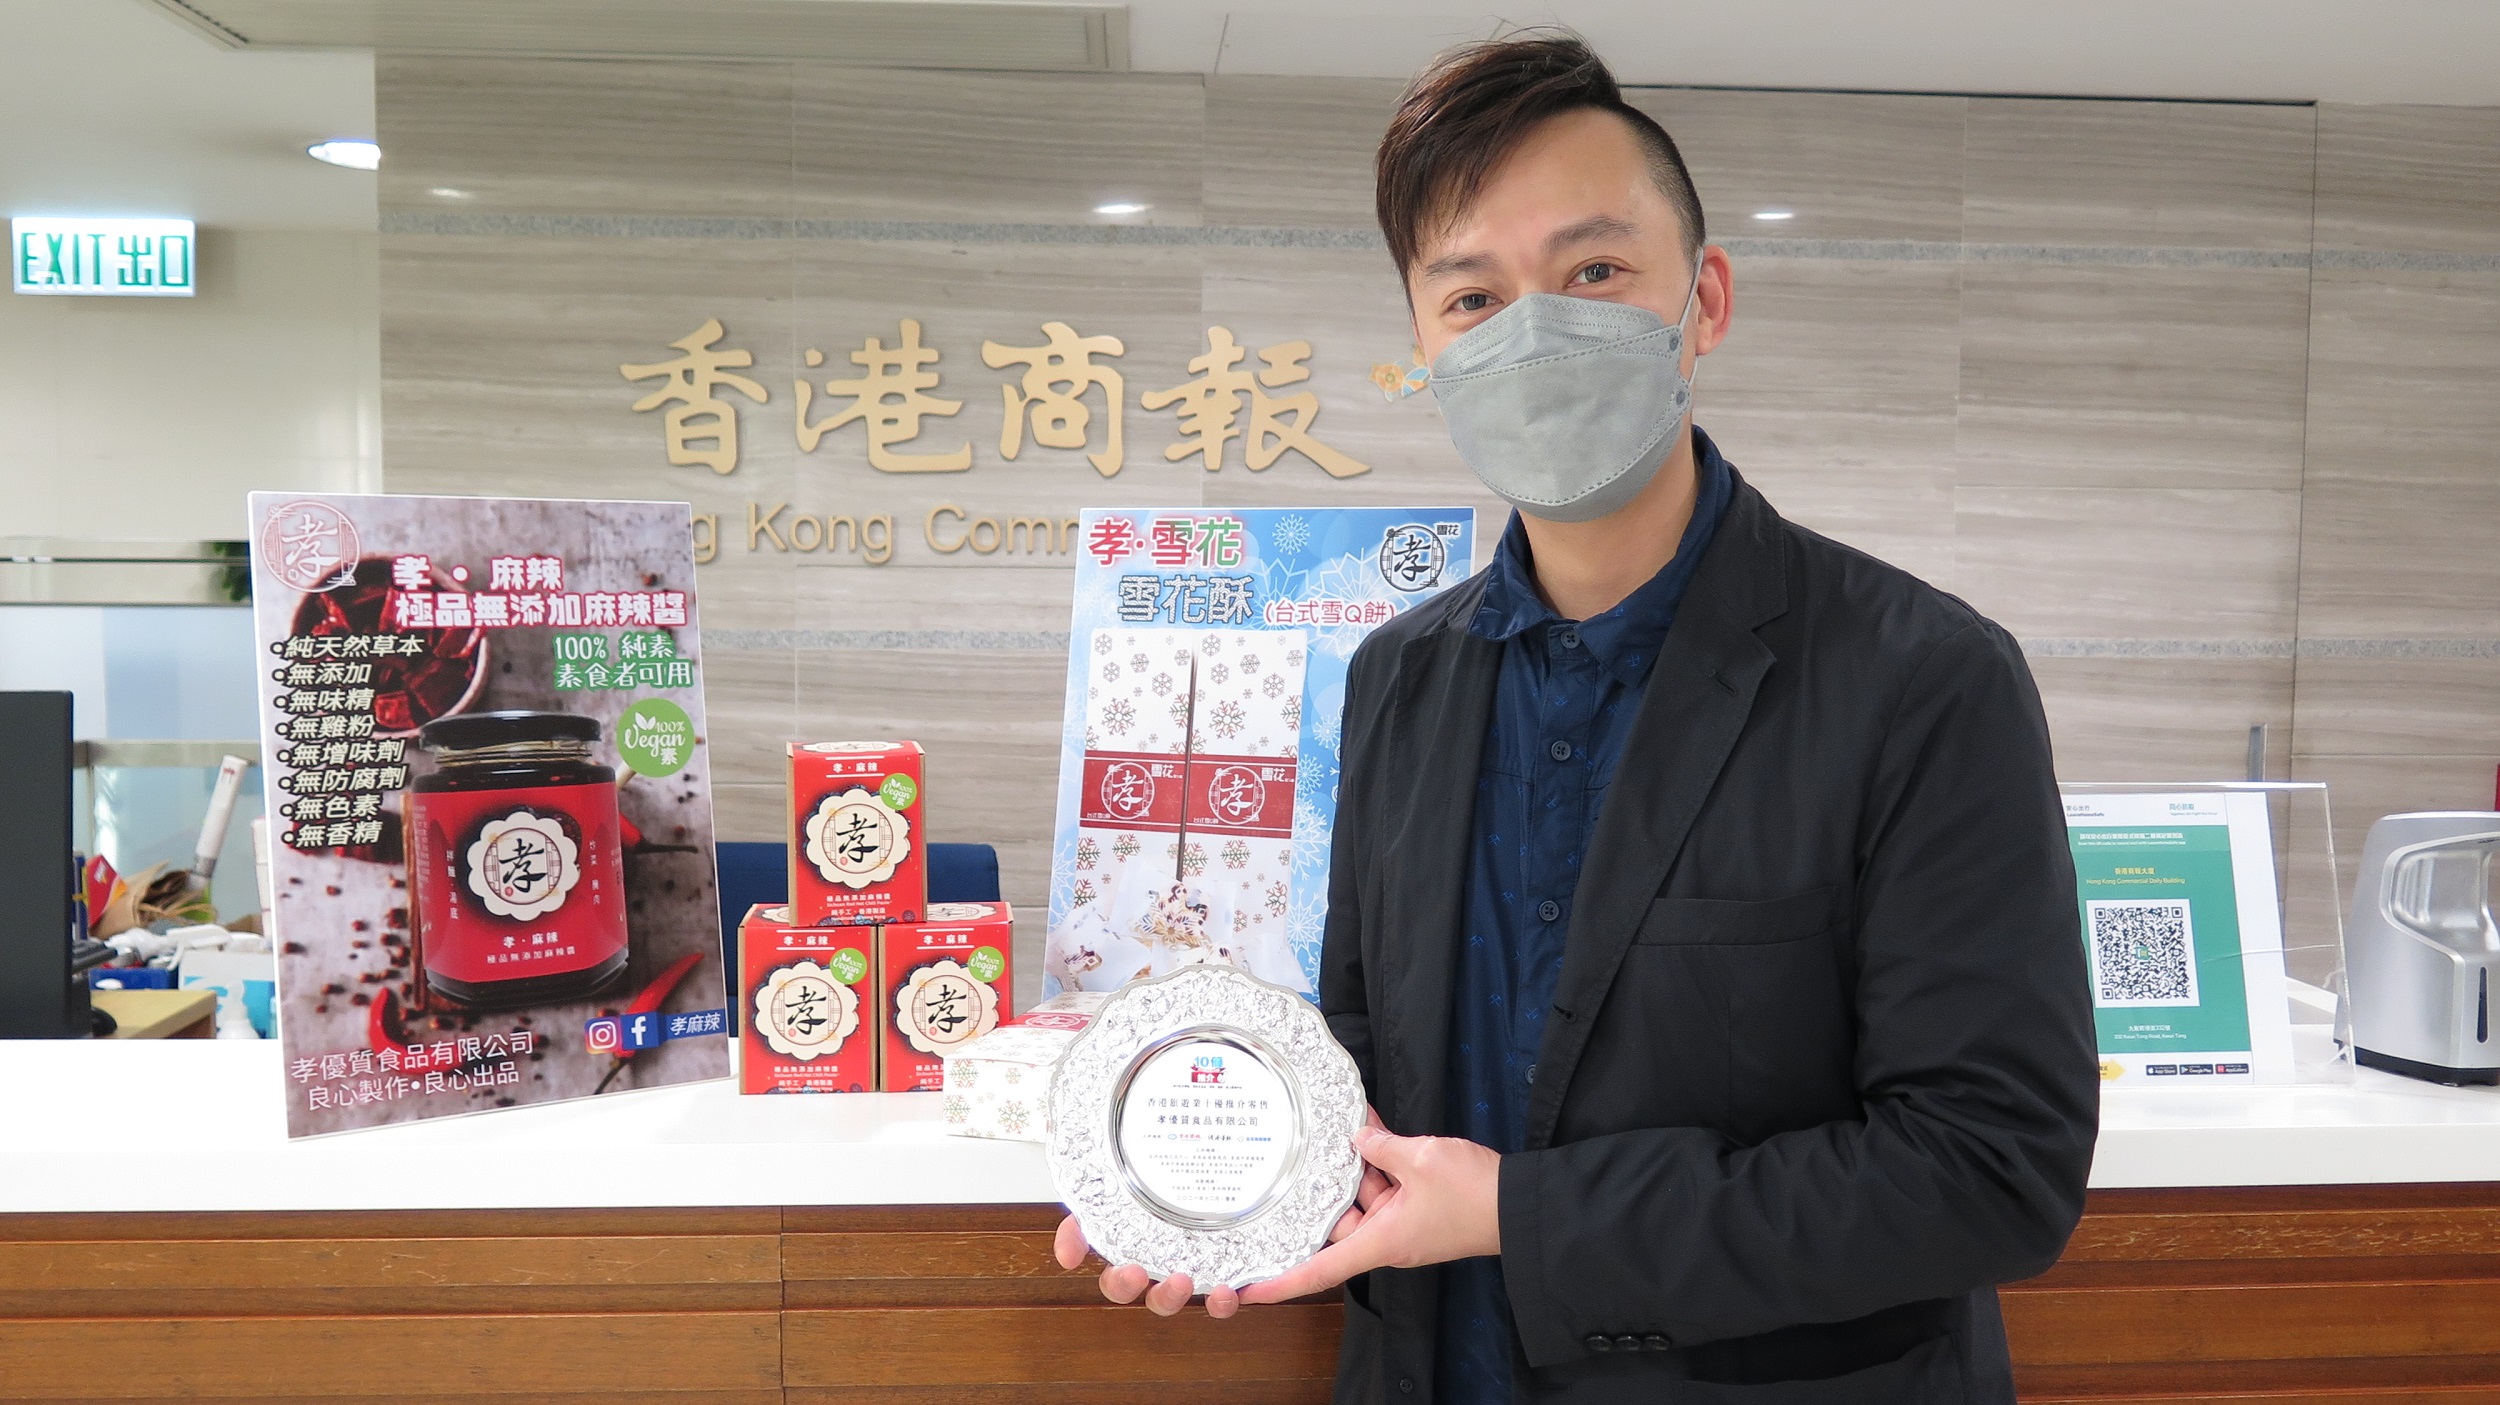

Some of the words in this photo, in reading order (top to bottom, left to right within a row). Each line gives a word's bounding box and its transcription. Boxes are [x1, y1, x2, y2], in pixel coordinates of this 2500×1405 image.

[21, 232, 105, 285] EXIT
[118, 235, 189, 287] 出口
[620, 318, 1372, 479] 香港商報
[747, 502, 894, 565] Kong
[396, 592, 687, 627] 極品無添加麻辣醬
[1118, 575, 1255, 625] 雪花酥
[284, 635, 425, 659] 純天然草本
[555, 636, 607, 661] 100%
[621, 634, 673, 660] 純素
[287, 662, 372, 686] 無添加
[557, 662, 691, 688] 素食者可用
[289, 688, 375, 712] 無味精
[290, 714, 375, 740] 無雞粉
[656, 721, 685, 733] 100%
[292, 740, 406, 766] 無增味劑
[625, 724, 686, 757] Vegan
[660, 748, 679, 766] 素
[294, 766, 407, 794] 無防腐劑
[882, 782, 911, 801] Vegan
[295, 794, 380, 821] 無色素
[296, 821, 383, 848] 無香精
[833, 957, 860, 975] Vegan
[970, 957, 998, 974] Vegan
[670, 1013, 721, 1035] 孝麻辣
[291, 1032, 534, 1084] 孝優質食品有限公司
